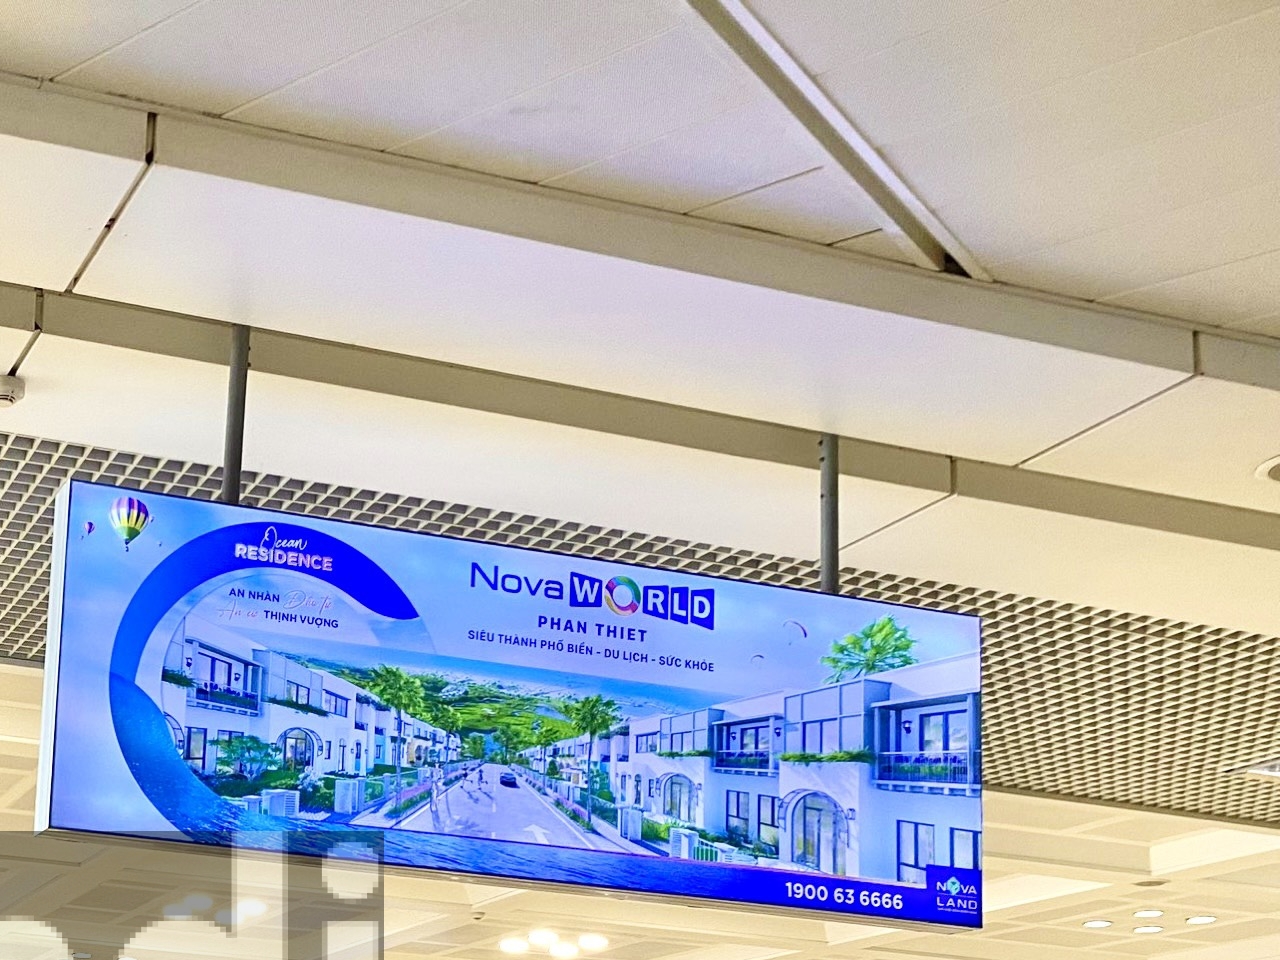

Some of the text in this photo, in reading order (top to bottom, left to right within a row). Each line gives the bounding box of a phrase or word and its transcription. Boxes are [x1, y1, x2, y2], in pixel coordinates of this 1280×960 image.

[260, 525, 307, 551] Ocean
[234, 543, 333, 572] RESIDENCE
[229, 587, 245, 598] AN
[248, 588, 280, 603] NHÀN
[263, 609, 297, 624] THỊNH
[300, 614, 339, 629] VƯỢNG
[537, 615, 648, 642] PHAN THIET
[468, 629, 495, 643] SIÊU
[498, 632, 537, 648] THÀNH
[604, 648, 620, 659] DU
[623, 650, 648, 664] LỊCH
[658, 654, 682, 668] SỨC
[684, 658, 715, 672] KHỎE
[785, 881, 903, 910] 1900 63 6666
[936, 897, 978, 910] LAND
